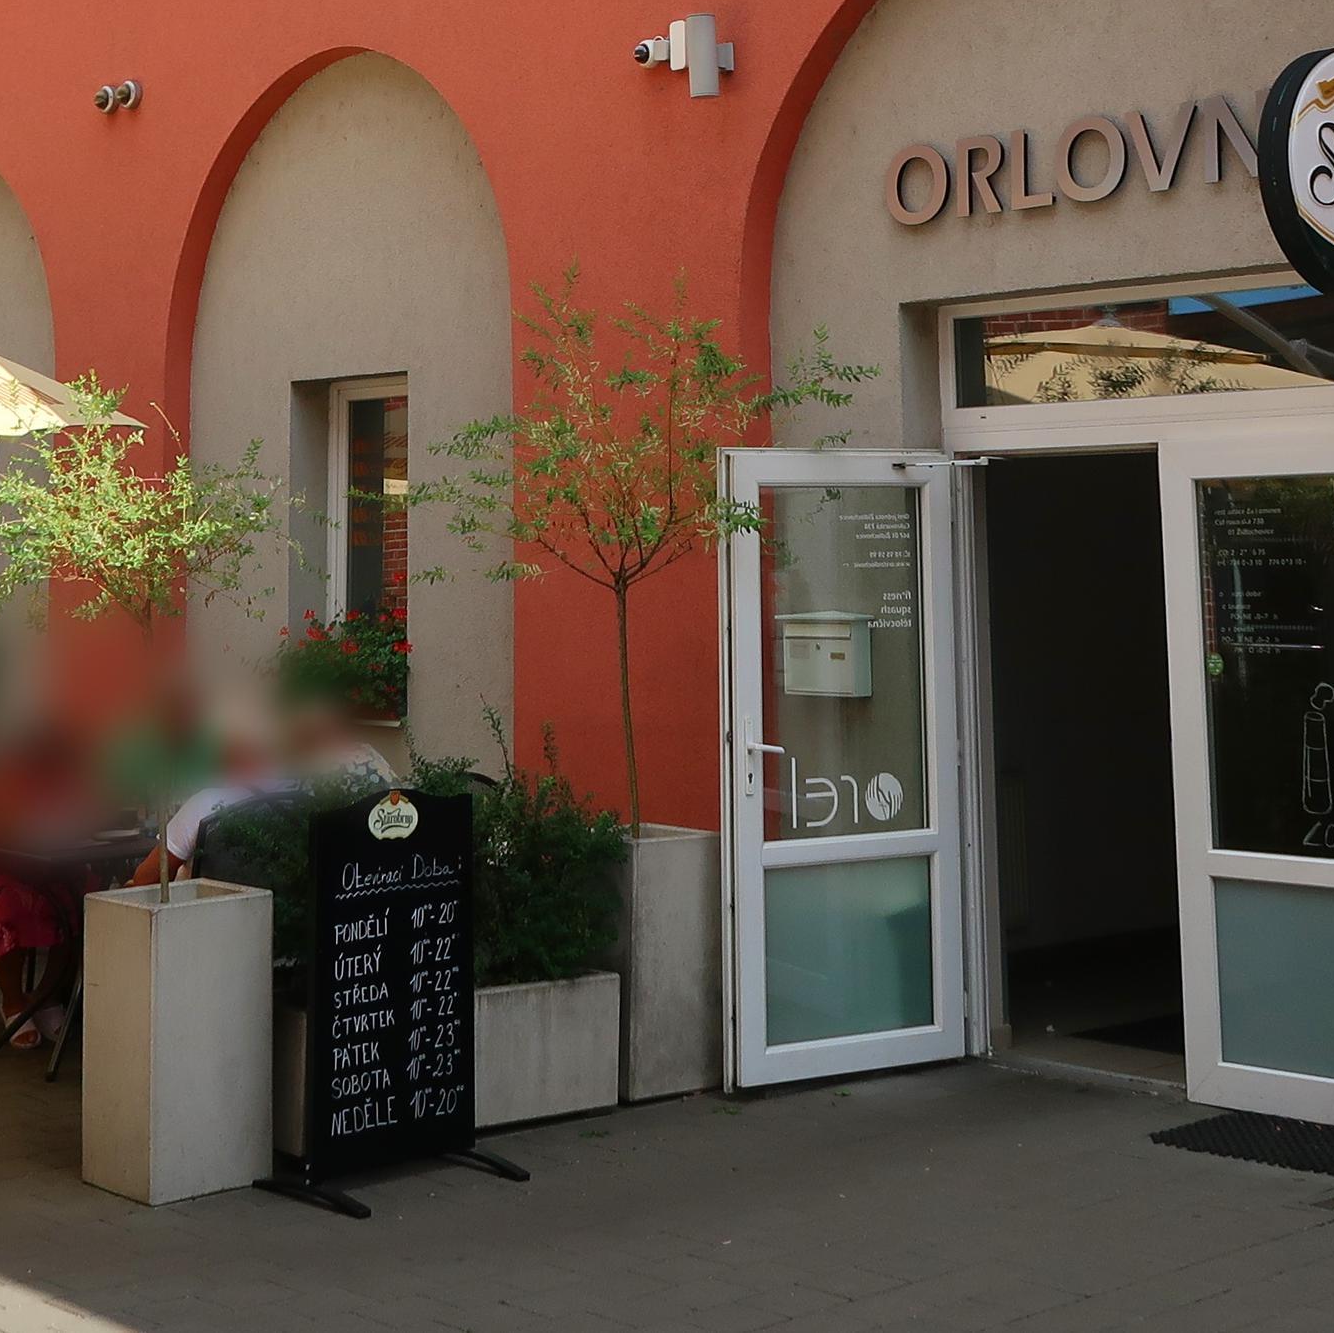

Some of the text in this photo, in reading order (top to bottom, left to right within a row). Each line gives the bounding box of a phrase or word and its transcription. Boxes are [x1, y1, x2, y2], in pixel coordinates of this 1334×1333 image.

[885, 91, 1261, 227] ORLOVN
[373, 808, 414, 834] Starobrno
[334, 907, 390, 945] PONDĚLÍ
[334, 944, 381, 981] ÚTERÝ
[334, 982, 389, 1009] STŘEDA
[332, 1009, 395, 1039] ČTVRTEK
[331, 1069, 391, 1099] SOBOTA
[331, 1096, 398, 1136] NEDĚLE
